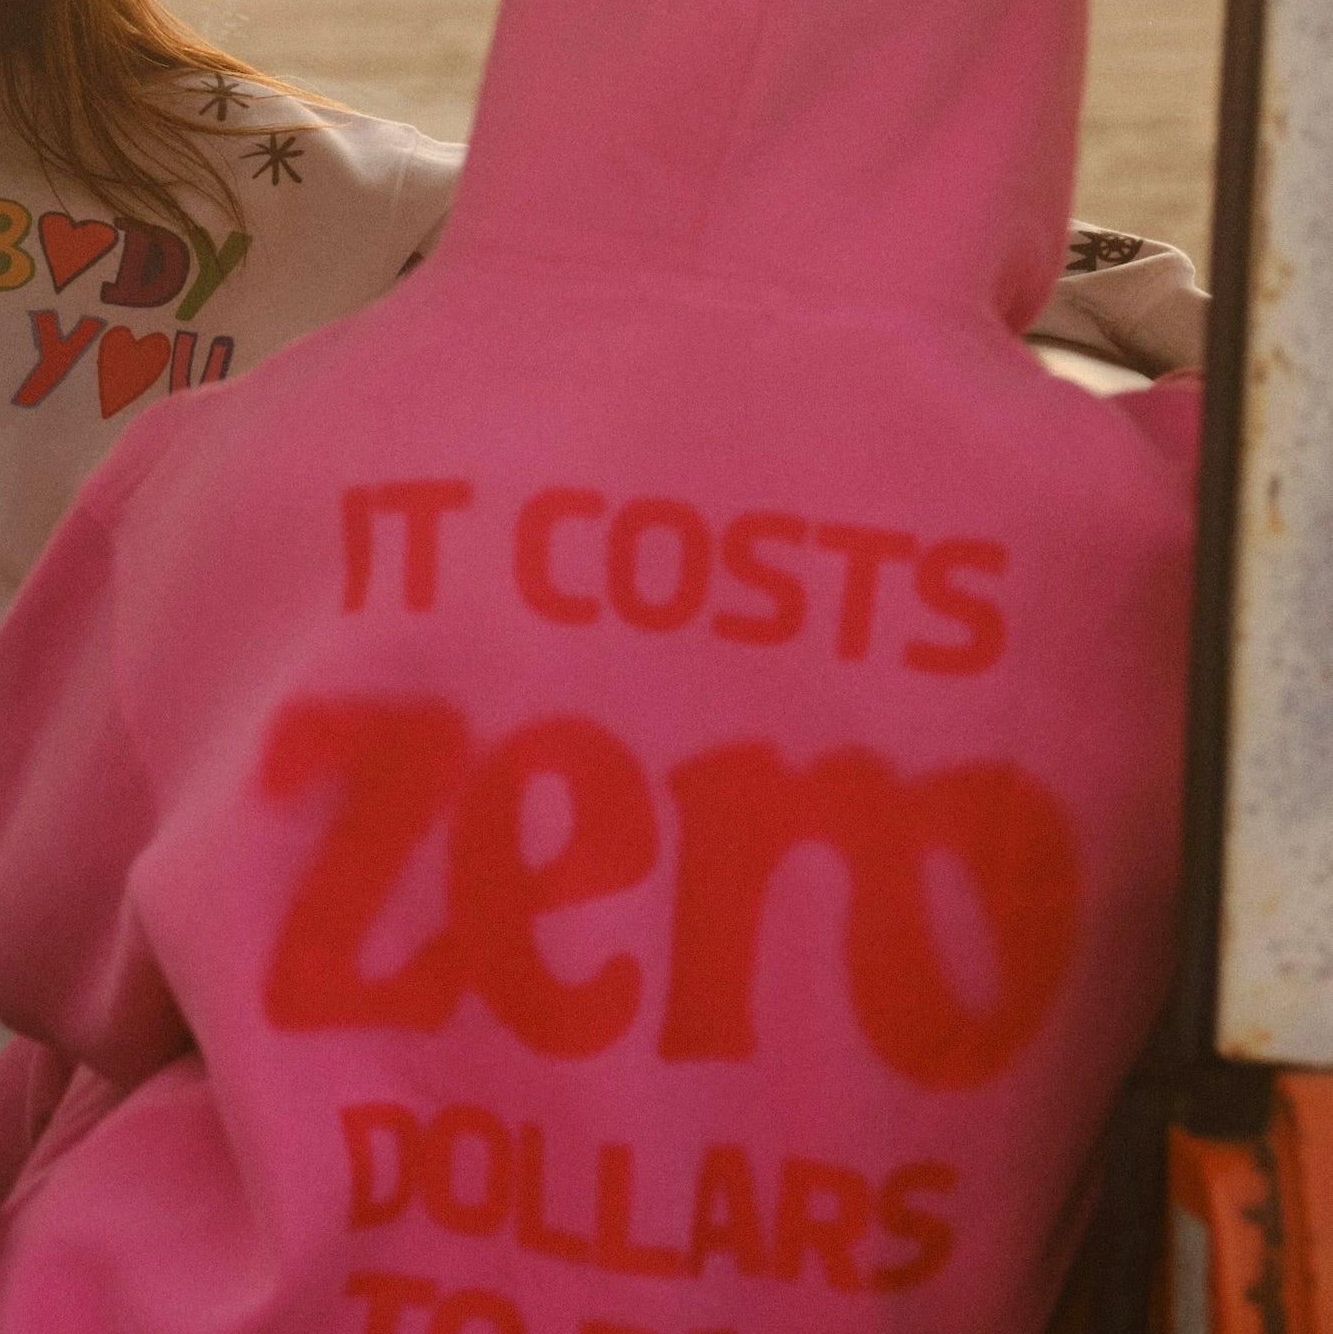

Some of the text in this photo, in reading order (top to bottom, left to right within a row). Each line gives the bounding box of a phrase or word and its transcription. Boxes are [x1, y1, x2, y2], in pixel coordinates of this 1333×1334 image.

[341, 480, 1009, 677] IT COSTS
[339, 1104, 957, 1295] DOLLARS
